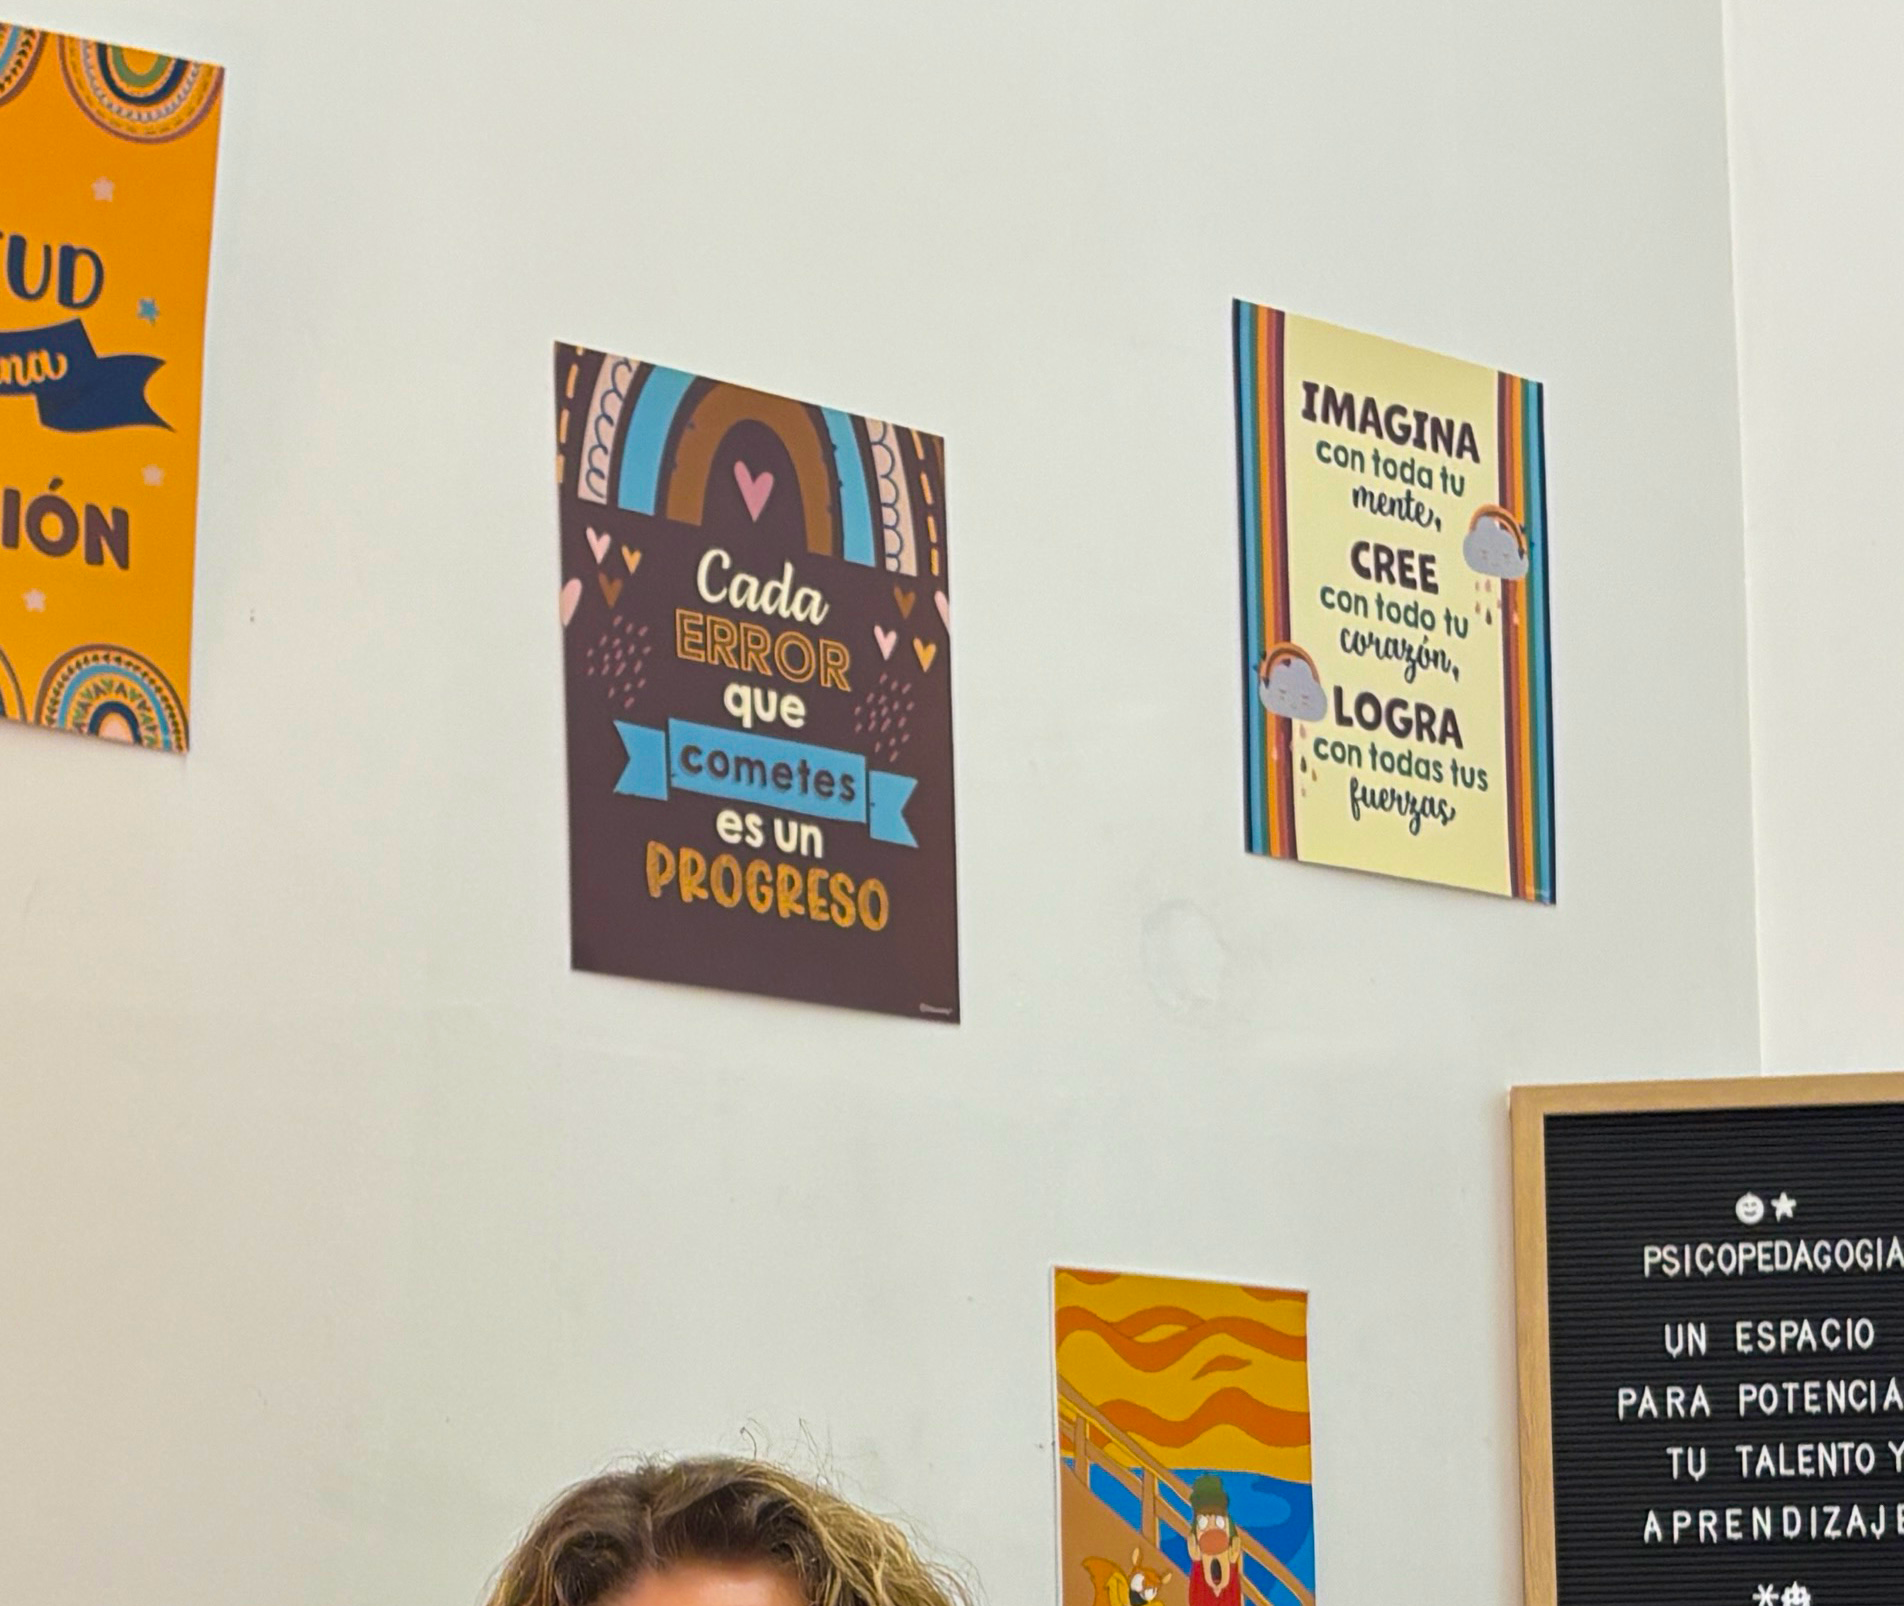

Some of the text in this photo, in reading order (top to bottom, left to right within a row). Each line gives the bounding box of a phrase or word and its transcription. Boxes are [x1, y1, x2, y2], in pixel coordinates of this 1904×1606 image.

[1301, 381, 1480, 464] IMAGINA
[1316, 438, 1465, 497] con toda tu
[1352, 485, 1442, 532] mente,
[696, 548, 830, 626] Cada
[1350, 540, 1439, 595] CREE
[1320, 585, 1468, 639] con todo tu
[675, 608, 852, 692] ERROR
[1340, 626, 1460, 683] corazón,
[724, 681, 807, 730] que
[1333, 685, 1464, 749] LOGRA
[680, 743, 857, 802] cometes
[1313, 732, 1489, 793] con todas tus
[716, 810, 824, 859] es un
[1349, 777, 1457, 836] fuerzas
[645, 840, 890, 932] PROGRESO
[1664, 1317, 1876, 1358] UN ESPACIO
[1617, 1385, 1711, 1420] PARA
[1666, 1446, 1706, 1481] TU
[1736, 1441, 1876, 1478] TALENTO
